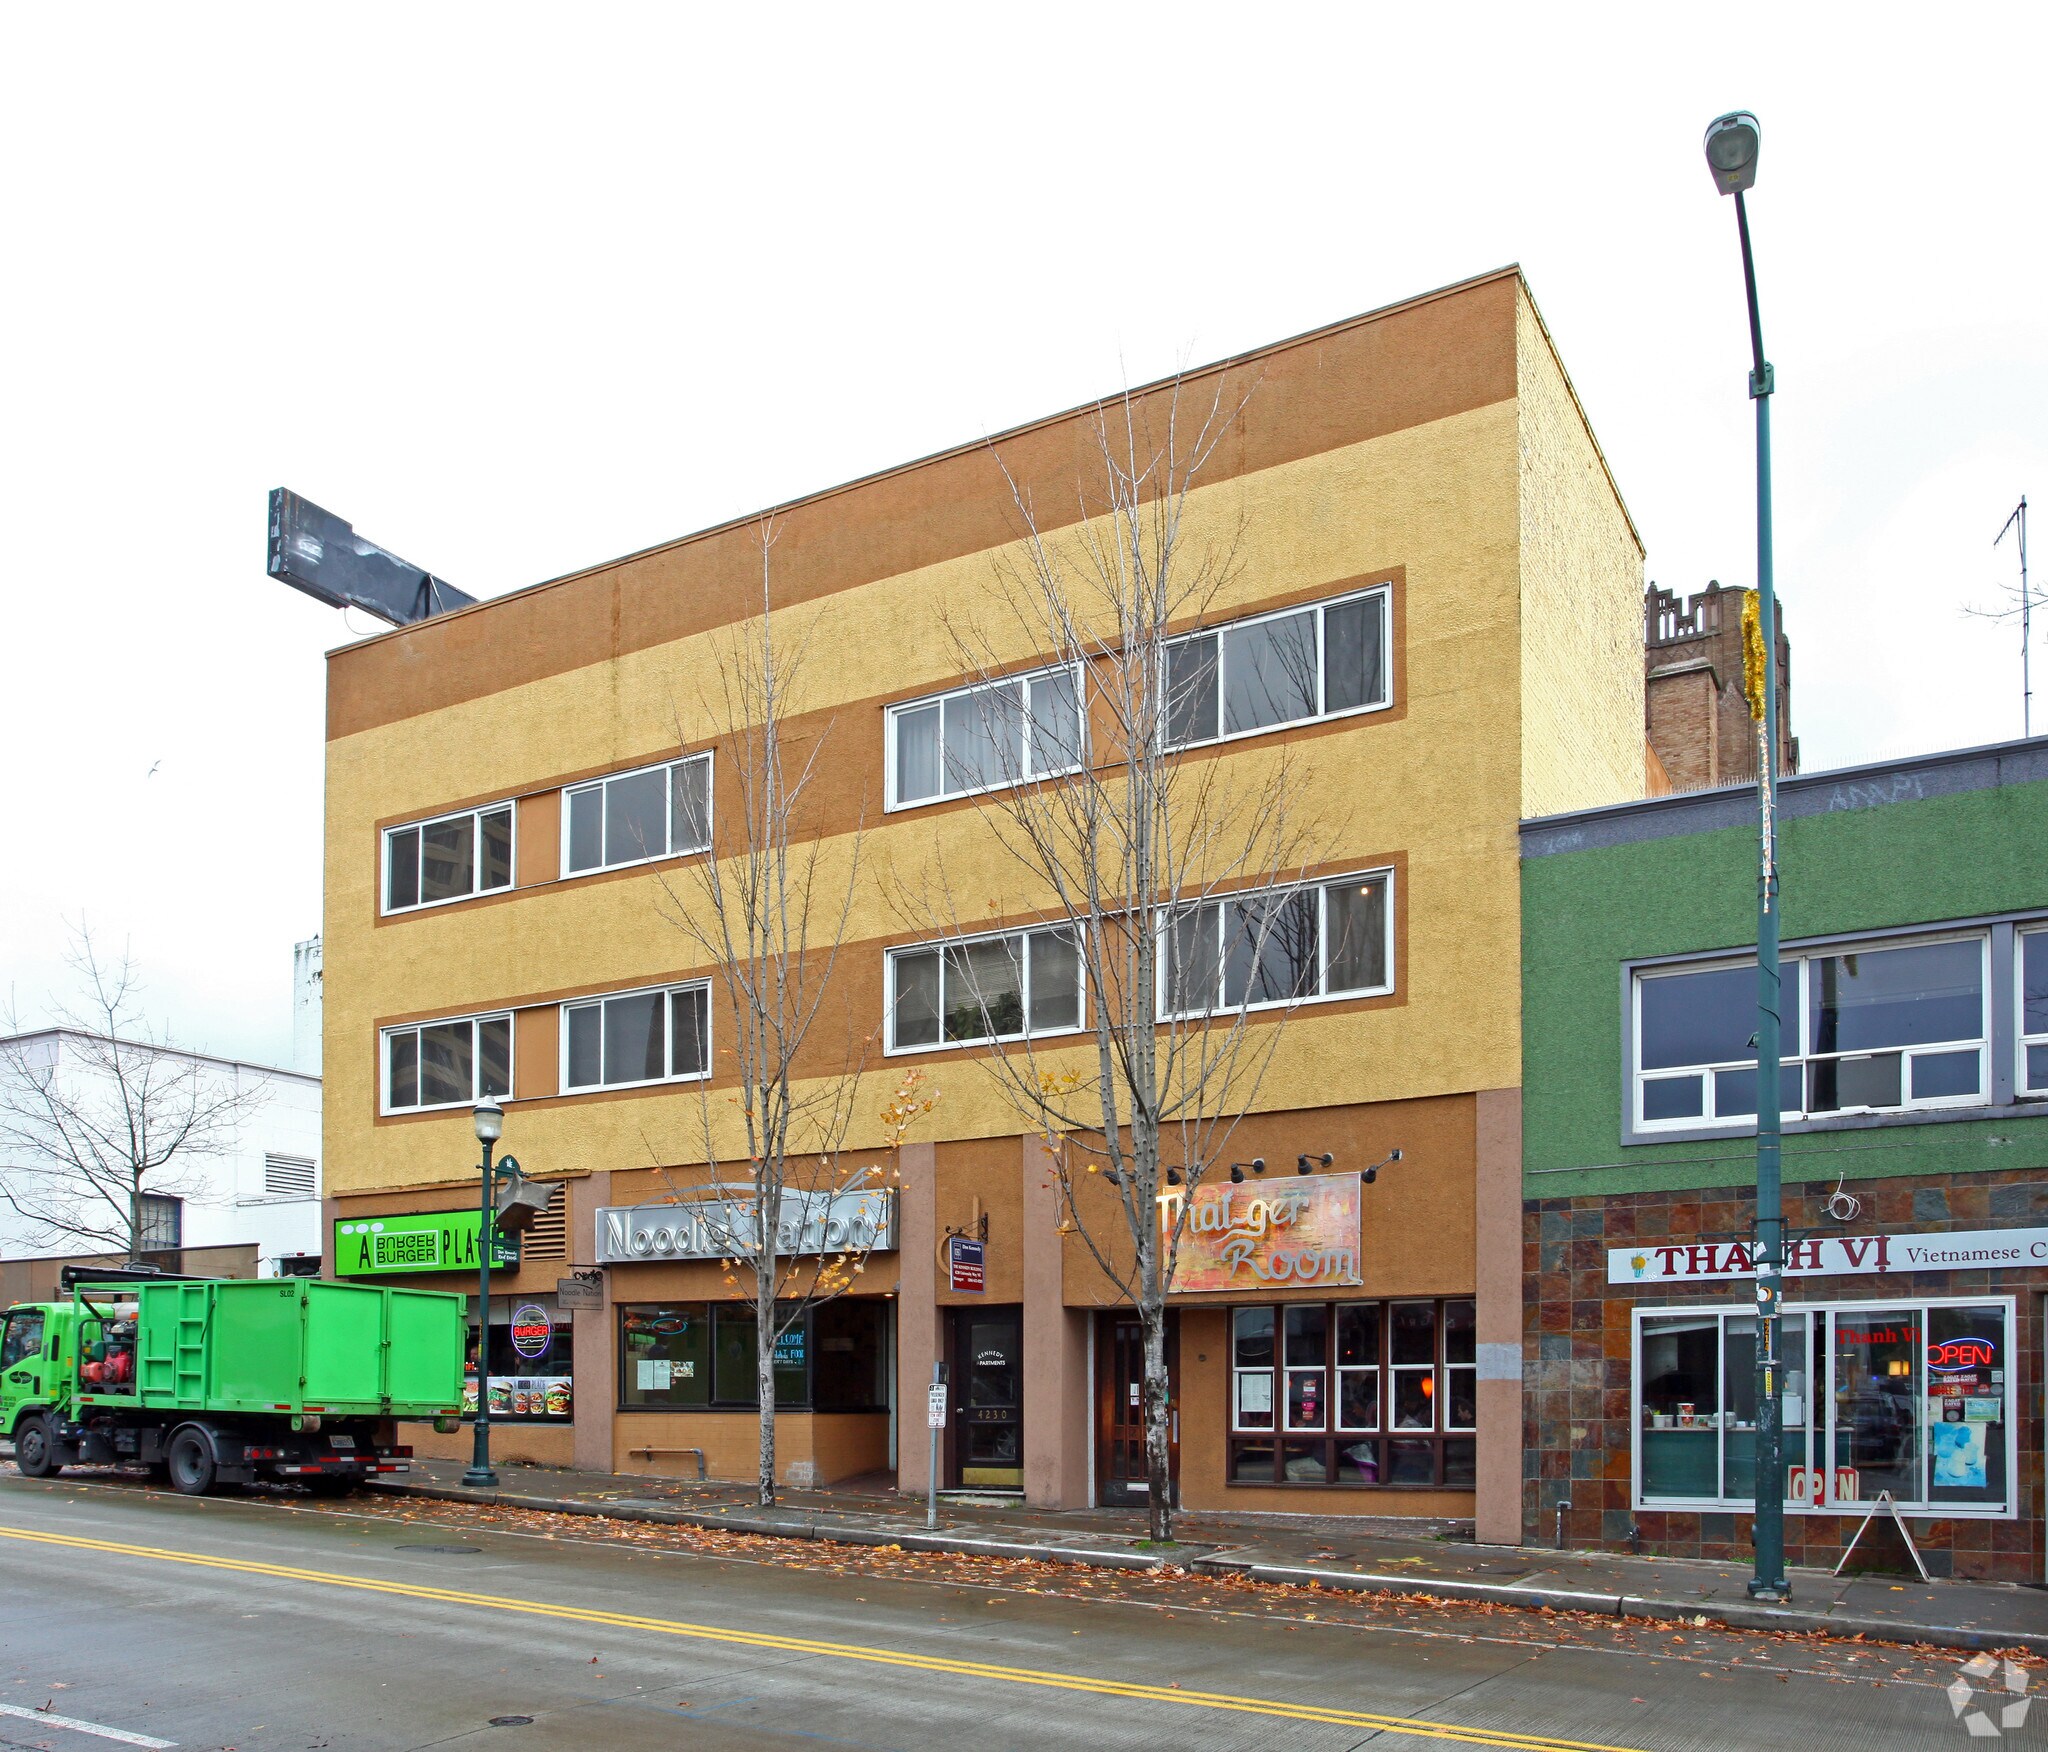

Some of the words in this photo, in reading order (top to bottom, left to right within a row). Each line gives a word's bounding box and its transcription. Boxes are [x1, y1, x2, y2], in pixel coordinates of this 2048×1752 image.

[607, 1209, 730, 1257] Noodle
[756, 1208, 873, 1249] ation
[359, 1235, 371, 1268] A
[377, 1249, 436, 1263] BURGER
[1654, 1240, 1824, 1275] THAH
[1906, 1248, 2021, 1264] Vietnamese
[1221, 1238, 1364, 1286] Room
[560, 1288, 581, 1297] Noodle
[514, 1326, 548, 1337] BURGER
[1836, 1328, 1898, 1345] Thanh
[1902, 1327, 1920, 1344] Vi
[977, 1350, 1004, 1359] KENNEDY
[1928, 1345, 1992, 1365] OPEN
[978, 1410, 1007, 1419] 4230
[1793, 1472, 1854, 1500] OPN
